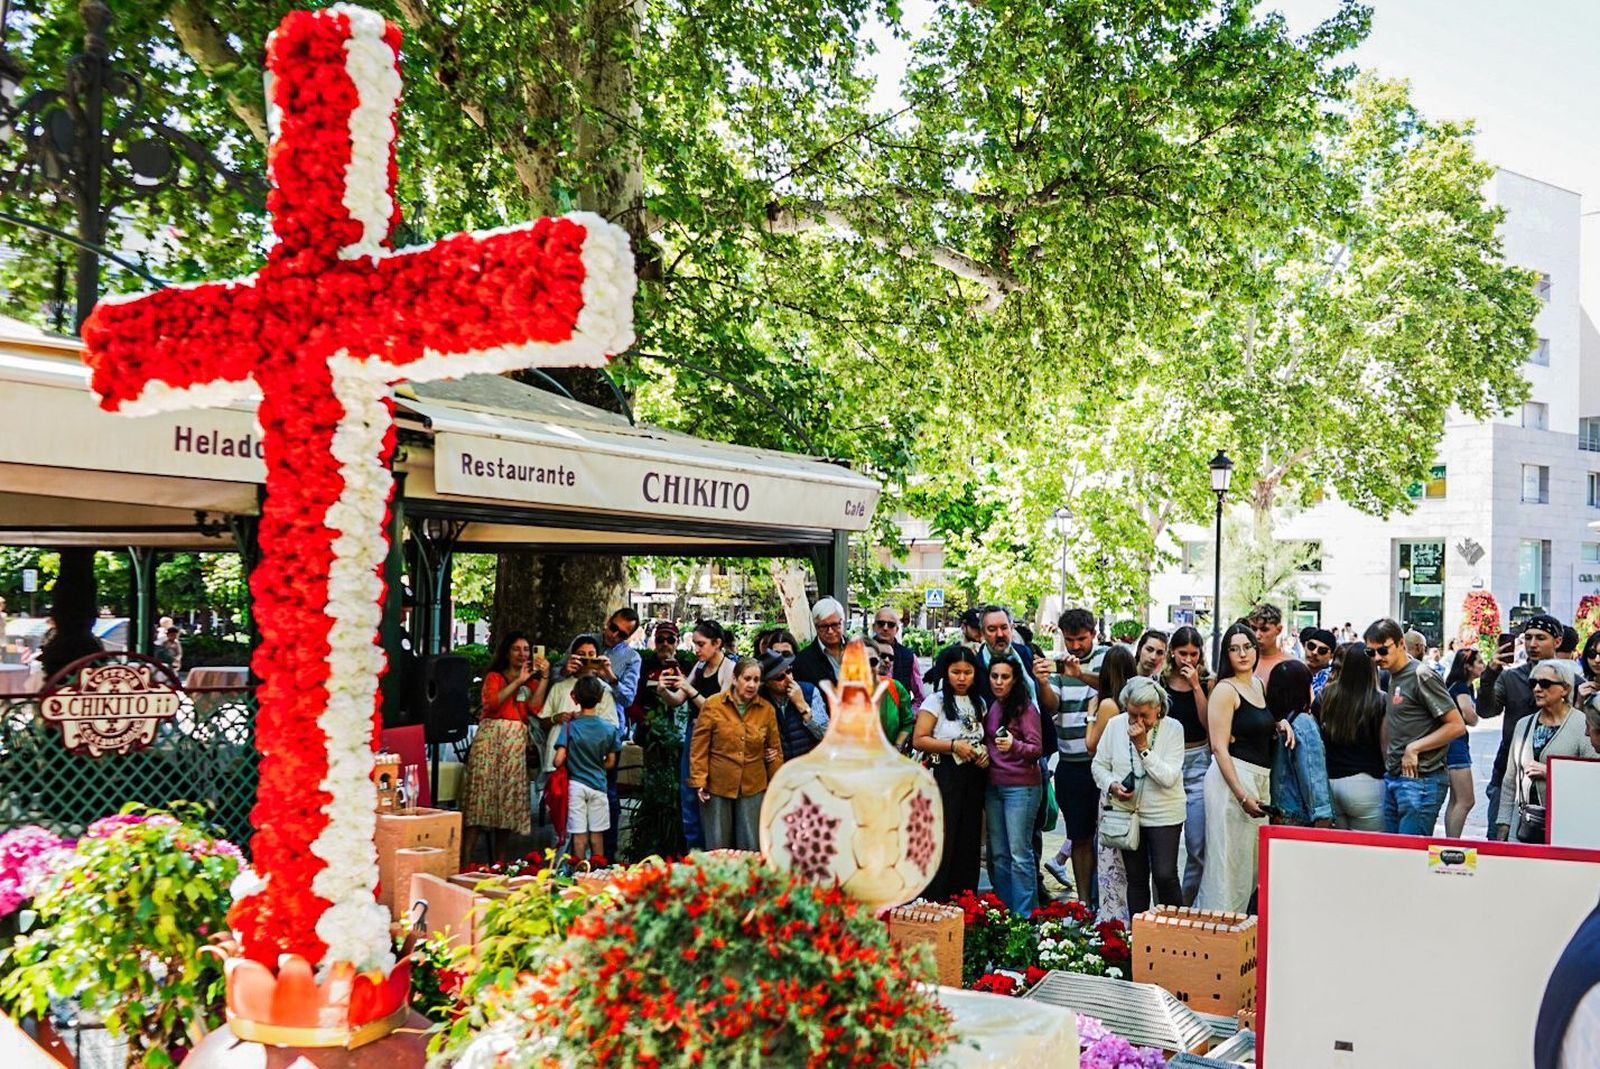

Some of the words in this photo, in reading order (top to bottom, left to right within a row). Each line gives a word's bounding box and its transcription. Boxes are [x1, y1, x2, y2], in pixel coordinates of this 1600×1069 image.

[461, 452, 576, 487] Restaurante
[642, 471, 750, 512] CHIKITO
[845, 499, 865, 517] Café
[68, 696, 149, 717] CHIKITO
